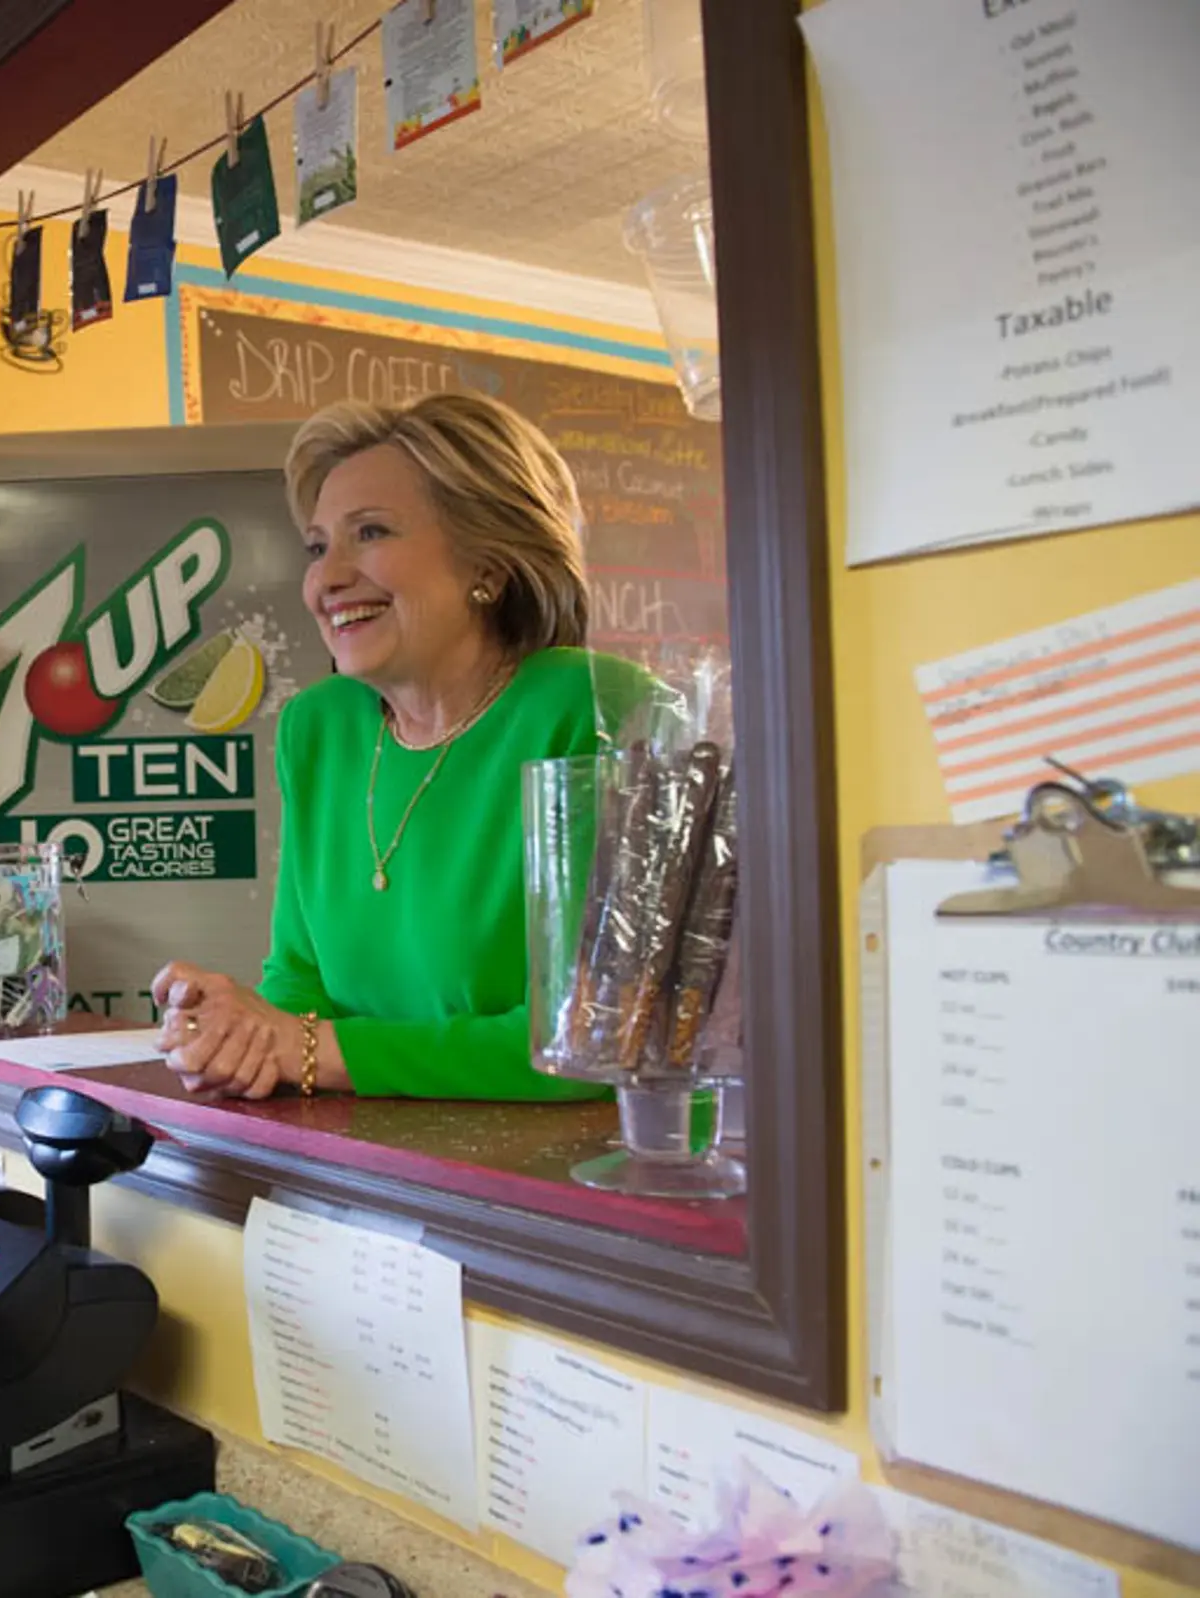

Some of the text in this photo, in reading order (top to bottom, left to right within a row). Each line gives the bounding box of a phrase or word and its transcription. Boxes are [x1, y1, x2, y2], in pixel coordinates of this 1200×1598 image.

[995, 288, 1113, 339] Taxable
[229, 329, 334, 407] DRIP
[593, 579, 670, 637] NCH
[78, 741, 238, 797] TEN
[107, 815, 214, 843] GREAT
[108, 843, 215, 862] TASTING
[108, 860, 216, 878] CALORIES
[1045, 928, 1143, 955] Country
[67, 990, 123, 1018] AT
